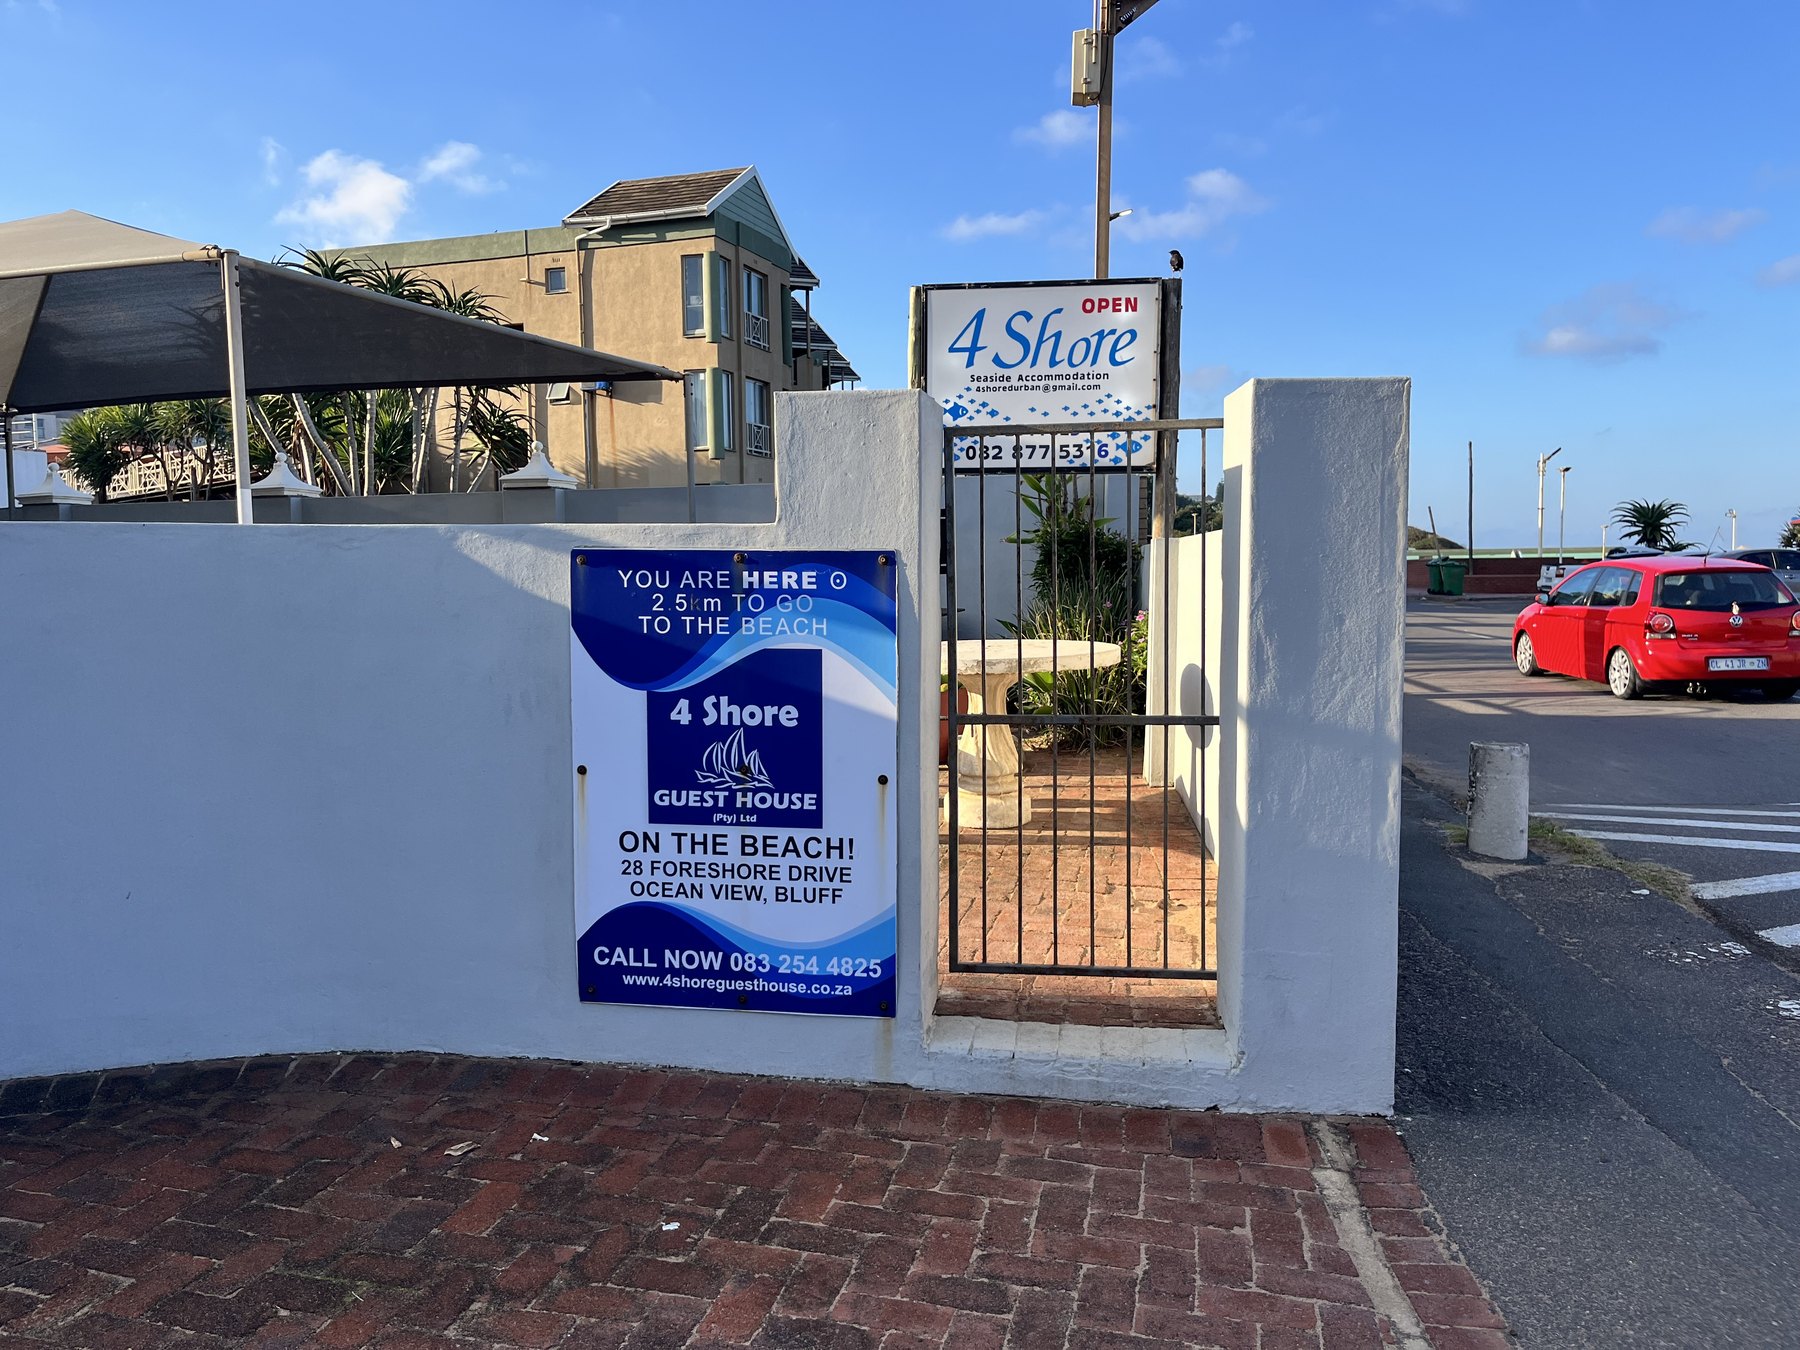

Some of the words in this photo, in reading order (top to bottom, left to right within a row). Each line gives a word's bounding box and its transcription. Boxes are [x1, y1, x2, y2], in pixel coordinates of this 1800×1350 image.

[1081, 297, 1138, 314] OPEN
[947, 307, 988, 369] 4
[991, 307, 1138, 369] Shore
[970, 373, 1012, 384] Seaside
[1017, 370, 1109, 382] Accommodation
[975, 382, 1101, 394] 4shoredurban@gmail.com
[965, 445, 1003, 461] 082
[1058, 443, 1109, 459] 536
[618, 570, 670, 589] YOU
[680, 570, 730, 589] ARE
[742, 571, 817, 590] HERE
[652, 593, 721, 612] 2.5km
[732, 594, 765, 612] TO
[776, 594, 813, 613] GO
[638, 616, 671, 634] TO
[681, 616, 730, 635] THE
[742, 617, 827, 636] BEACH
[670, 698, 692, 725] 4
[702, 695, 799, 727] Shore
[653, 789, 729, 808] GUEST
[735, 791, 817, 810] HOUSE
[712, 813, 737, 824] (Pty)
[740, 813, 757, 823] Ltd
[618, 830, 660, 854] ON
[671, 832, 729, 856] THE
[740, 834, 855, 860] BEACH!
[620, 859, 643, 876] 28
[650, 860, 781, 881] FORESHORE
[788, 865, 853, 883] DRIVE
[630, 880, 703, 899] OCEAN
[710, 883, 768, 904] VIEW,
[774, 886, 843, 904] BLUFF
[593, 946, 657, 967] CALL
[664, 949, 723, 971] NOW
[730, 952, 771, 973] 083
[777, 954, 819, 975] 254
[826, 956, 882, 978] 4825
[622, 973, 853, 996] www.4shoreguesthouse.co.za
